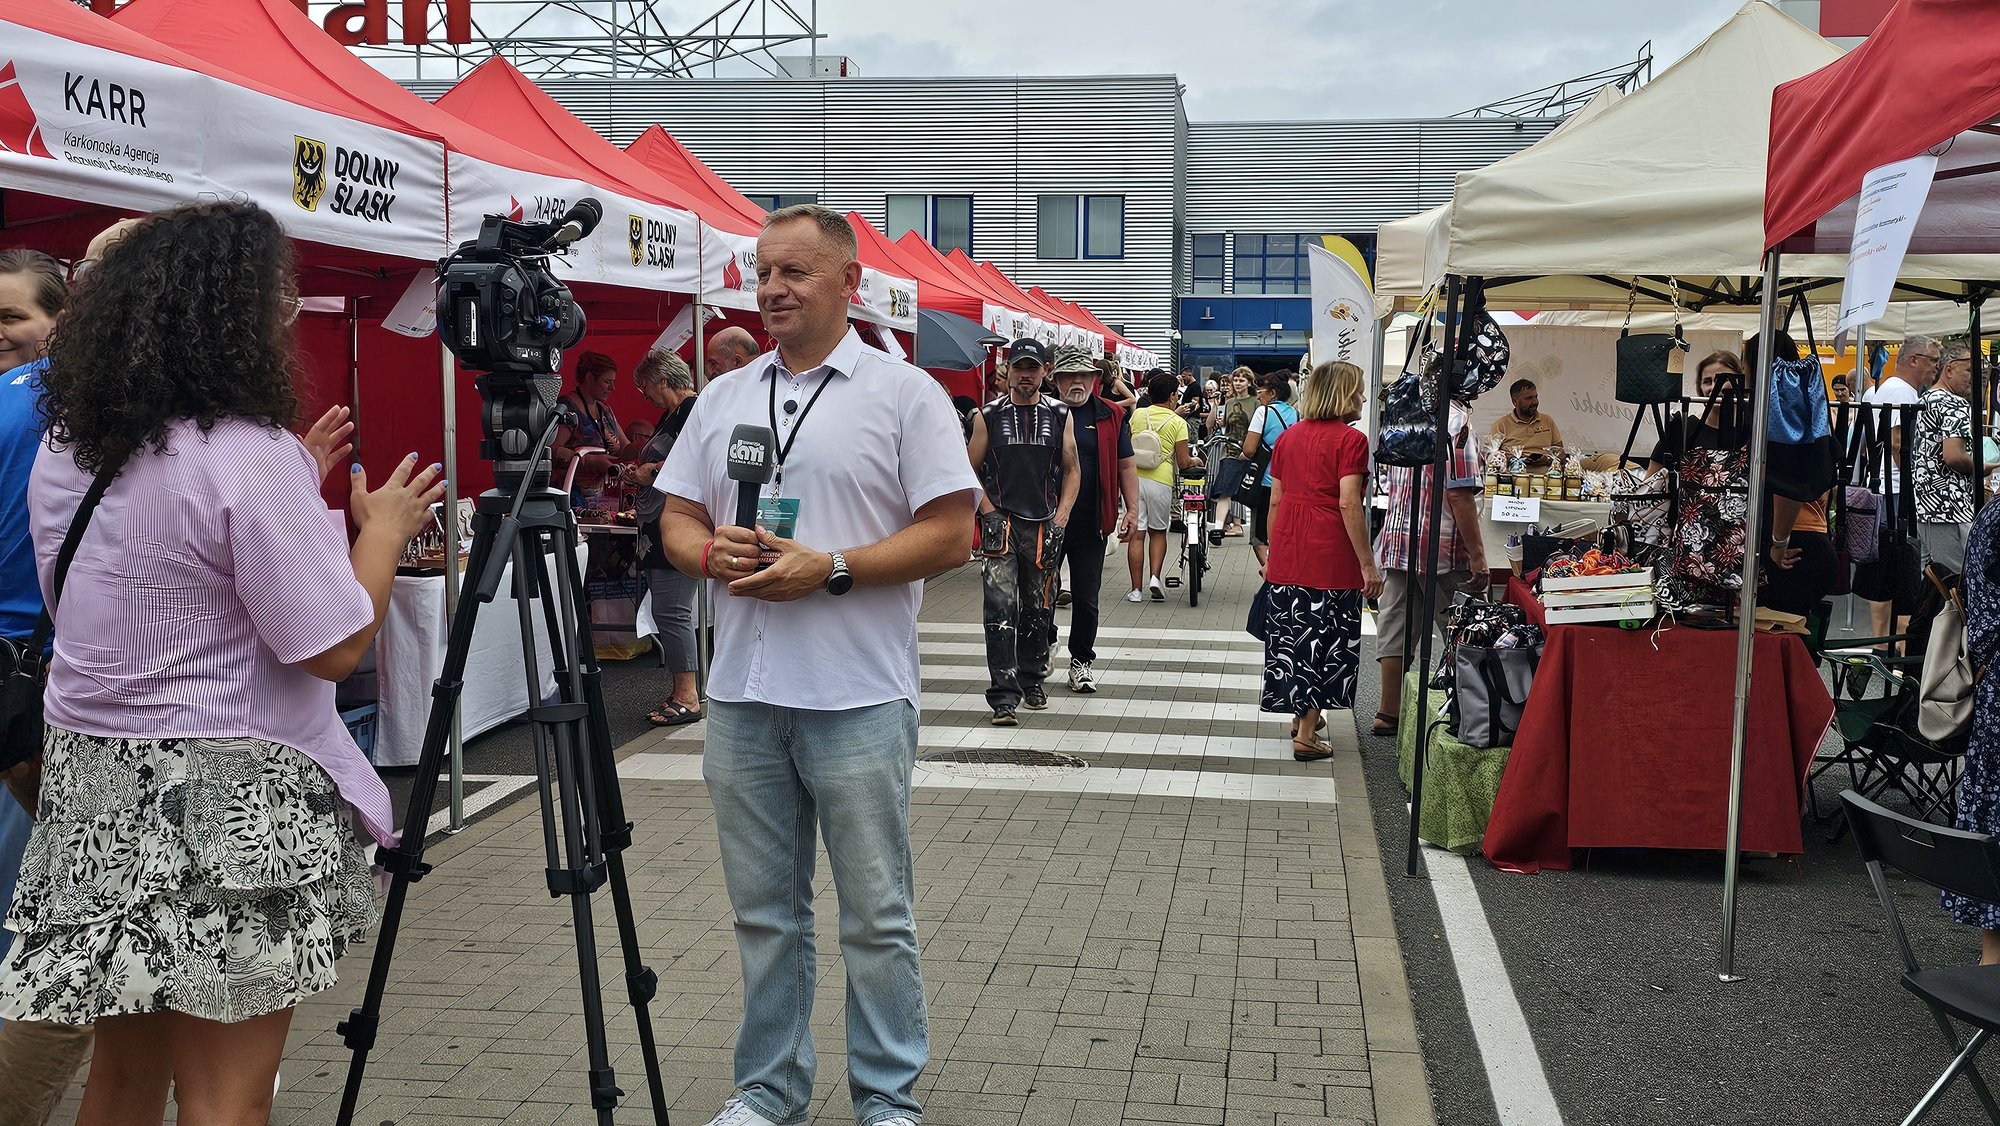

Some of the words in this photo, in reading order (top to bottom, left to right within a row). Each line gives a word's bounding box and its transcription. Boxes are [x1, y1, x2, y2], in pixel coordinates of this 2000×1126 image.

[324, 0, 472, 45] an
[64, 71, 147, 128] KARR
[63, 130, 121, 156] Karkonoska
[122, 143, 160, 165] Agencja
[335, 146, 400, 190] DOLNY
[329, 176, 397, 224] ŚLĄSK
[647, 218, 677, 246] DOLNY
